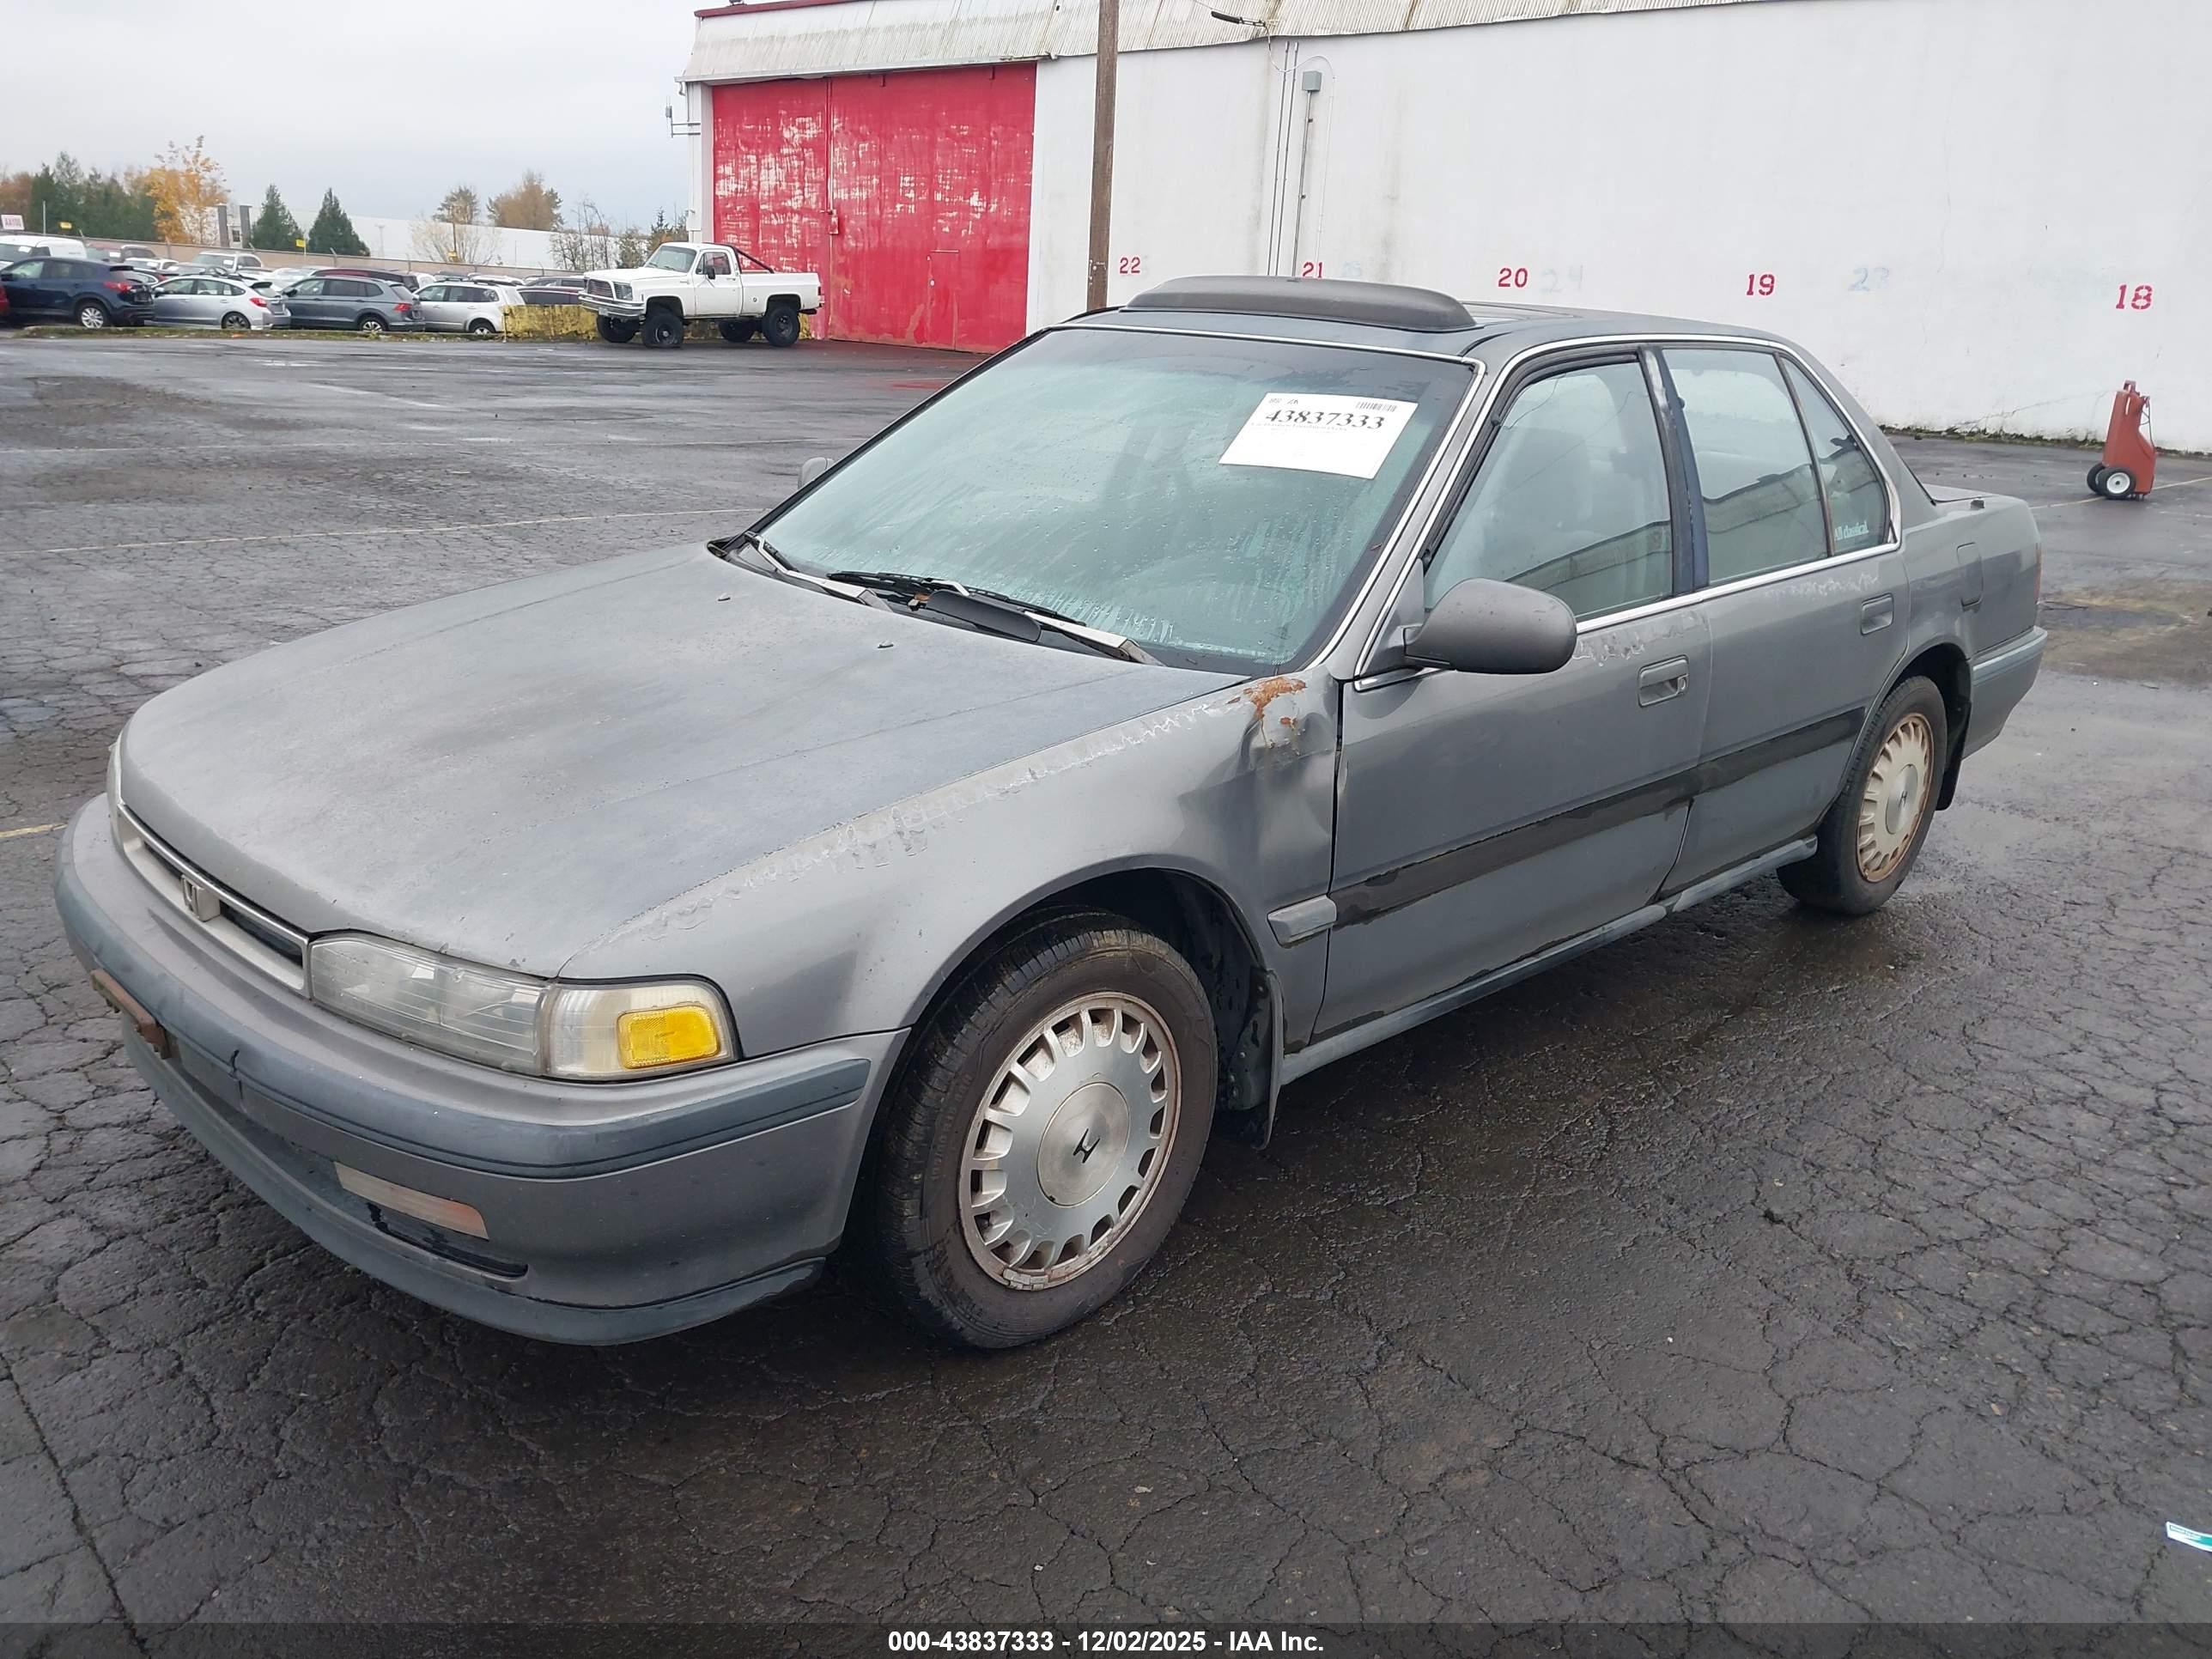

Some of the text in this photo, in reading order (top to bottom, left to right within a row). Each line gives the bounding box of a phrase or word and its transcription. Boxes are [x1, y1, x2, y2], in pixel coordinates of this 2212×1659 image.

[1119, 257, 1141, 275] 22
[1302, 261, 1323, 278] 21
[1498, 267, 1528, 289] 20
[1746, 273, 1776, 296] 19
[2115, 283, 2154, 310] 18
[1265, 409, 1386, 429] 43837333
